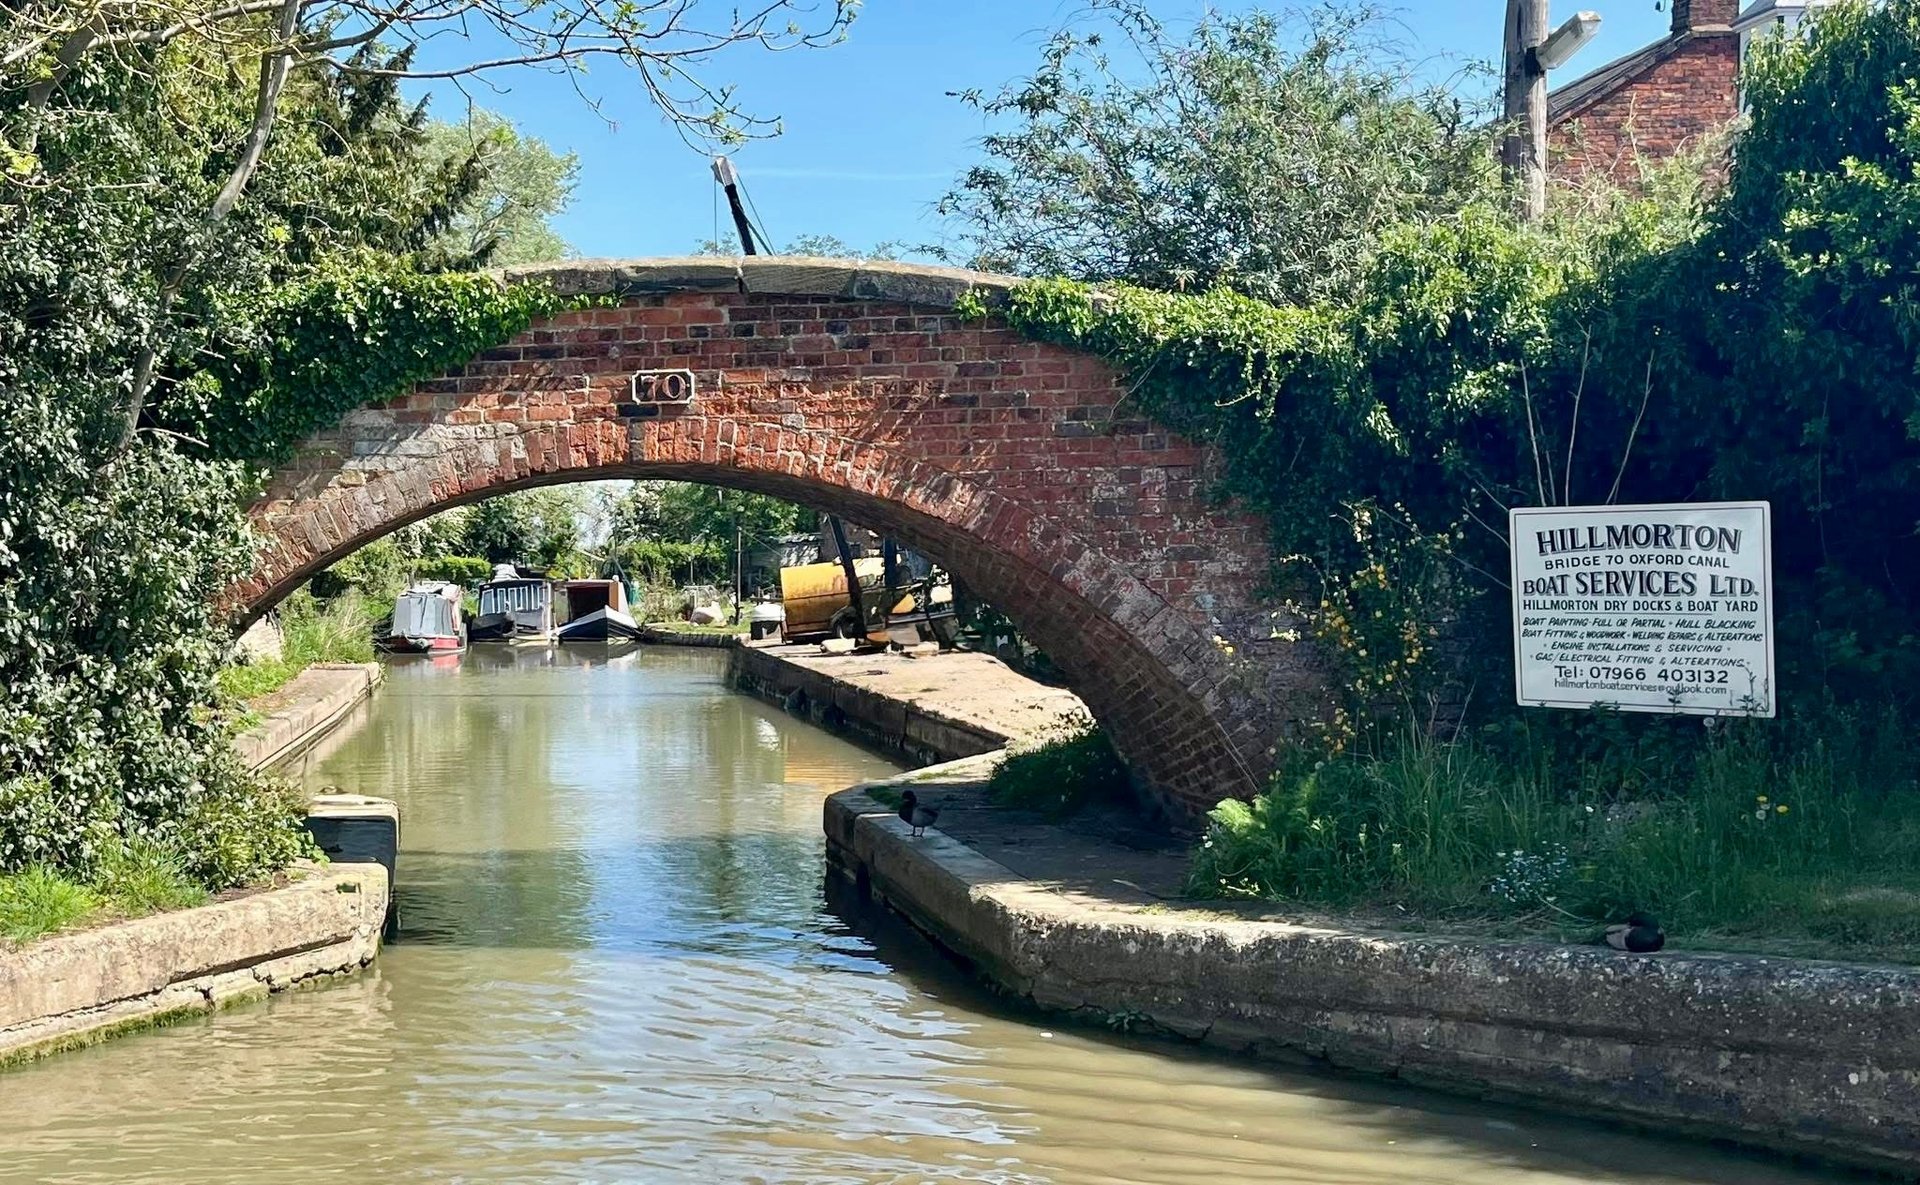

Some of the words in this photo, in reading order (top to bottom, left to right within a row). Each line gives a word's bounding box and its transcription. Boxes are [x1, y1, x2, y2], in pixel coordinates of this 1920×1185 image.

[641, 374, 686, 400] 70
[1536, 524, 1742, 556] HILLMORTON
[1544, 556, 1600, 570] BRIDGE
[1605, 554, 1624, 565] 70
[1630, 554, 1684, 566] OXFORD
[1688, 555, 1730, 568] CANAL
[1523, 574, 1570, 596] BOAT
[1576, 570, 1697, 596] SERVICES
[1710, 574, 1760, 597] LTD.
[1523, 600, 1598, 611] HILLMORTON
[1604, 600, 1628, 611] DRY
[1633, 600, 1671, 612] DOCKS
[1675, 602, 1683, 612] &
[1688, 600, 1719, 612] BOAT
[1725, 600, 1758, 612] YARD
[1522, 617, 1546, 626] BOAT
[1616, 618, 1628, 628] OR
[1631, 618, 1666, 628] PARTIAL
[1675, 619, 1700, 628] HULL
[1704, 620, 1756, 630] BLACKING
[1522, 629, 1543, 638] BOAT
[1544, 629, 1578, 638] FITTING
[1586, 631, 1626, 640] WOODWORK
[1632, 631, 1666, 640] WELDING
[1667, 632, 1697, 641] REPAIRS
[1704, 632, 1764, 642] ALTERATIONS
[1551, 642, 1585, 650] ENGINE
[1587, 643, 1650, 652] INSTALLATIONS
[1668, 644, 1722, 653] SERVICING
[1616, 654, 1654, 664] FITTING
[1670, 657, 1744, 668] ALTERATIONS
[1554, 666, 1584, 678] Tel:
[1590, 666, 1646, 681] 07966
[1657, 669, 1728, 684] 403132
